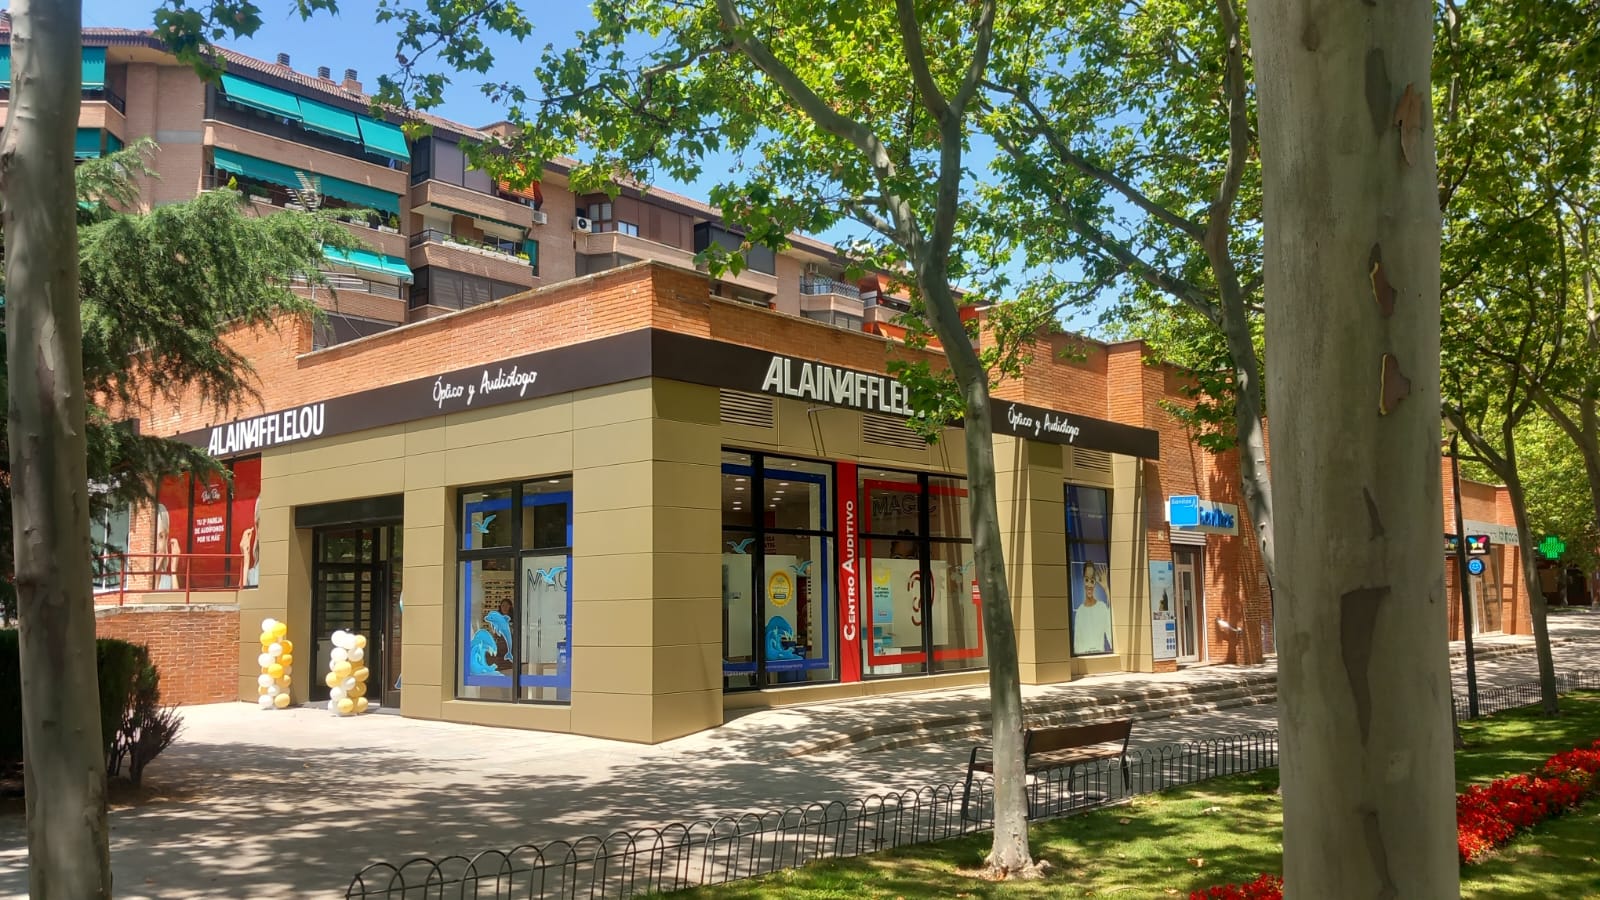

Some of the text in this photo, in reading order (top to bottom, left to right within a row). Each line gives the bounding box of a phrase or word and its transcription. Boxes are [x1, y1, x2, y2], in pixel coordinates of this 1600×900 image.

[432, 365, 538, 408] Óptico y Audiólogo
[1008, 403, 1079, 443] Óptico y Audiólogo
